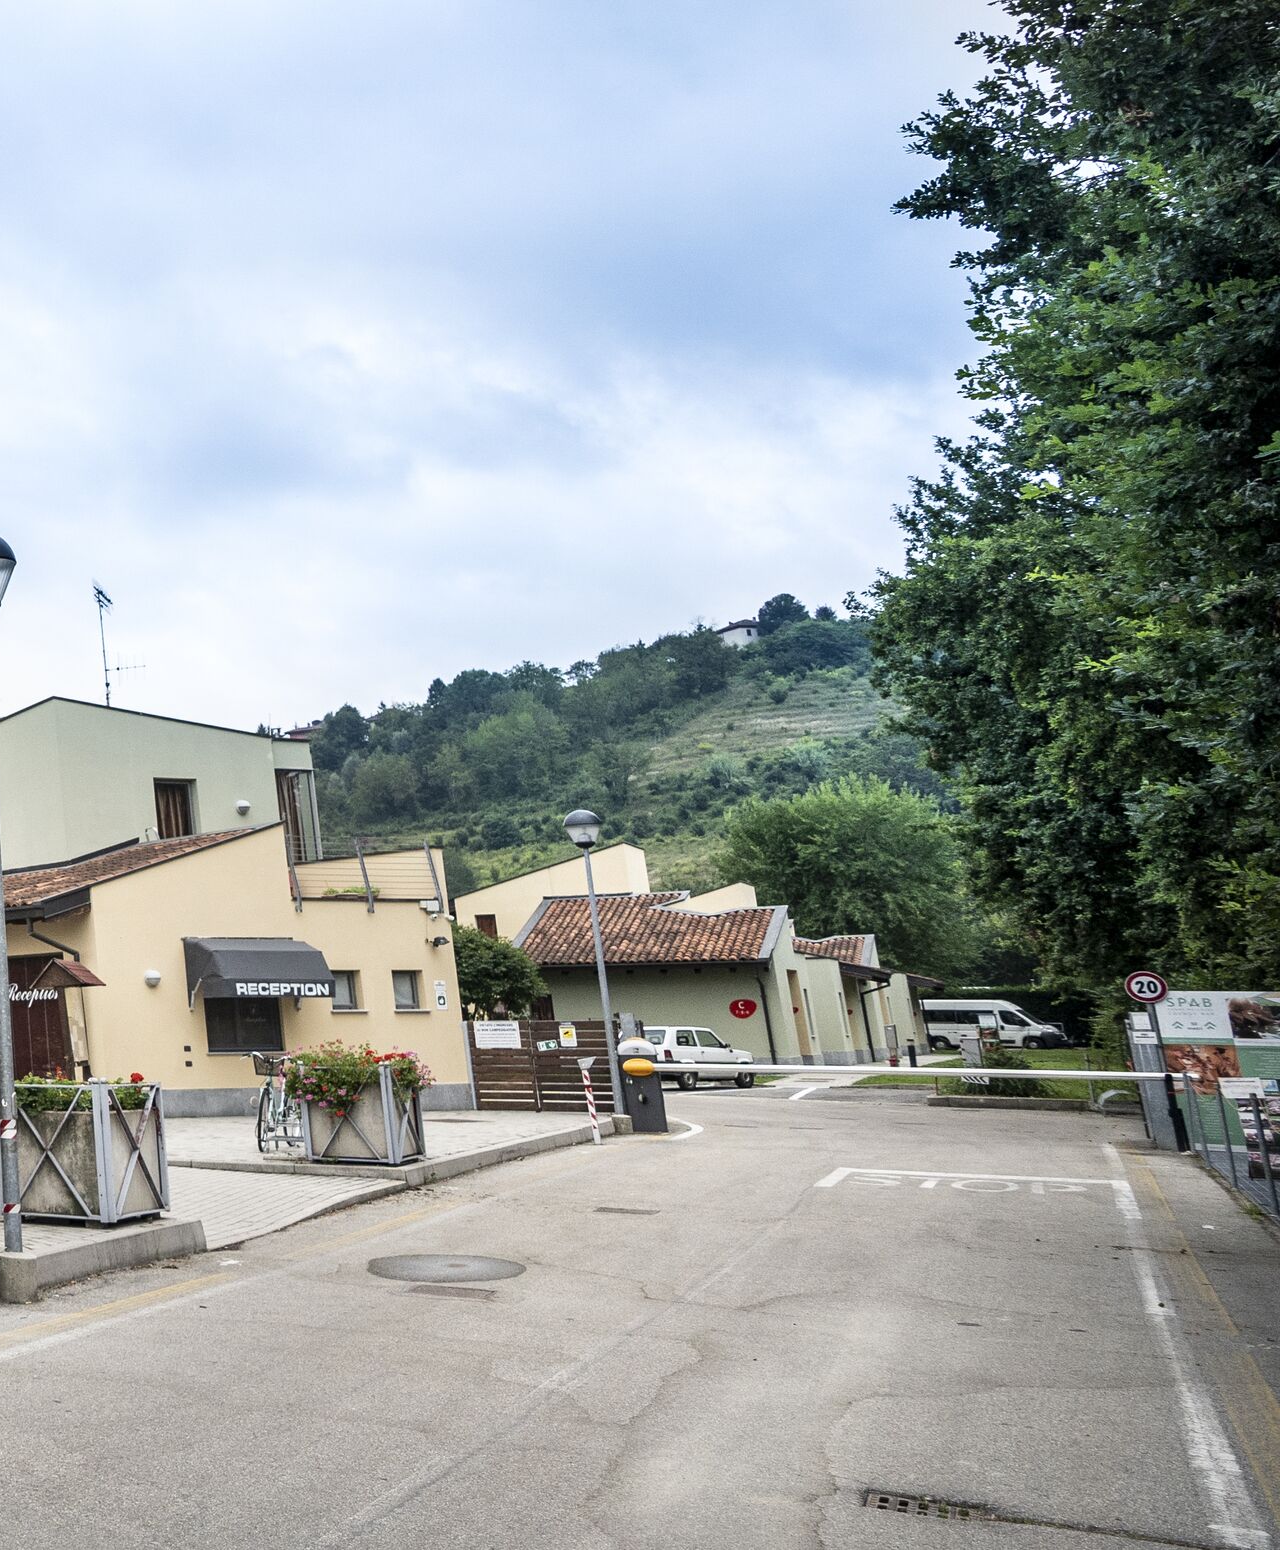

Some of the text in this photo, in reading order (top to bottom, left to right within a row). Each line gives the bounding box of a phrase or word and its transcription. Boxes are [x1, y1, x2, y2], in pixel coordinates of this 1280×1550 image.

[235, 982, 330, 996] RECEPTION
[1135, 980, 1159, 994] 20
[738, 1001, 745, 1009] C
[848, 1173, 1088, 1194] STOP
